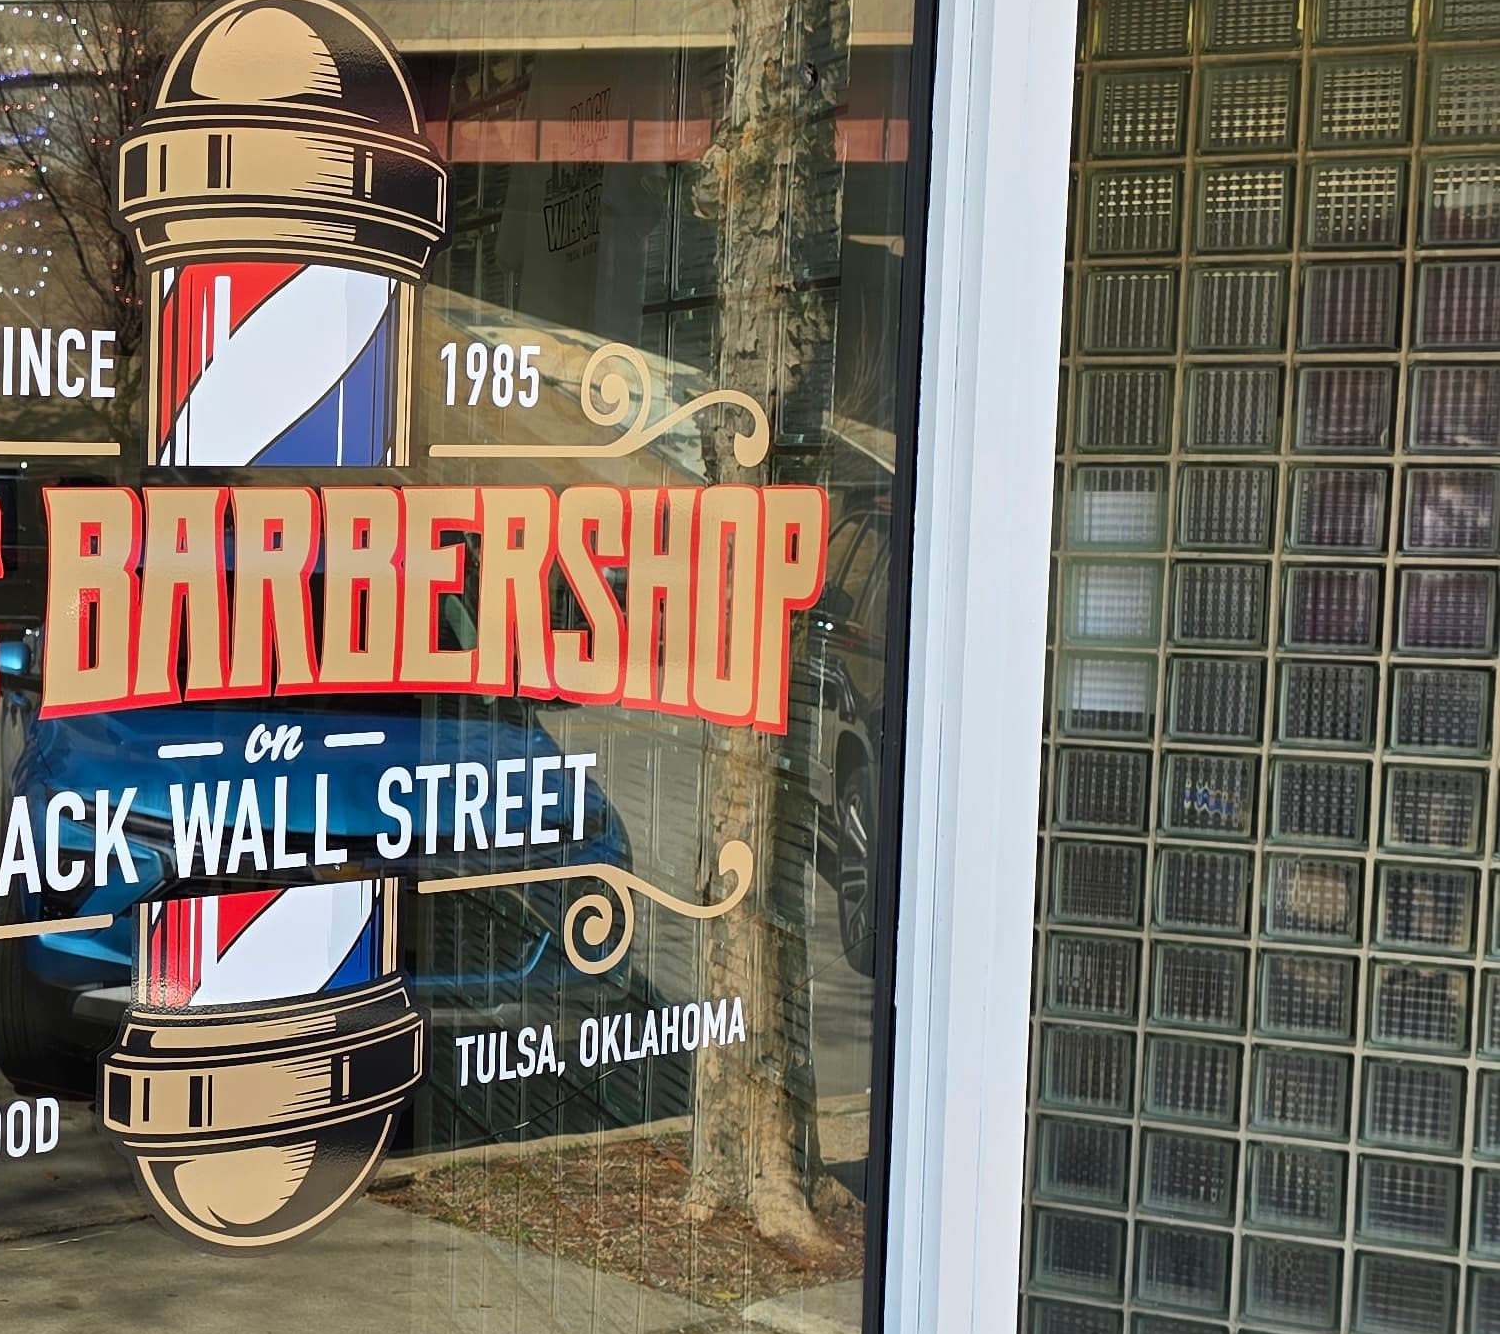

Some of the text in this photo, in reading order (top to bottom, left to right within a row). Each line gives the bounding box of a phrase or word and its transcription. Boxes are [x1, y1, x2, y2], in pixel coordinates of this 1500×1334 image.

[440, 342, 541, 409] 1985
[38, 485, 828, 735] BARBERSHOP
[244, 722, 304, 764] on
[170, 773, 348, 879] WALL
[376, 753, 597, 860] STREET
[455, 996, 746, 1087] TULSA, OKLAHOMA
